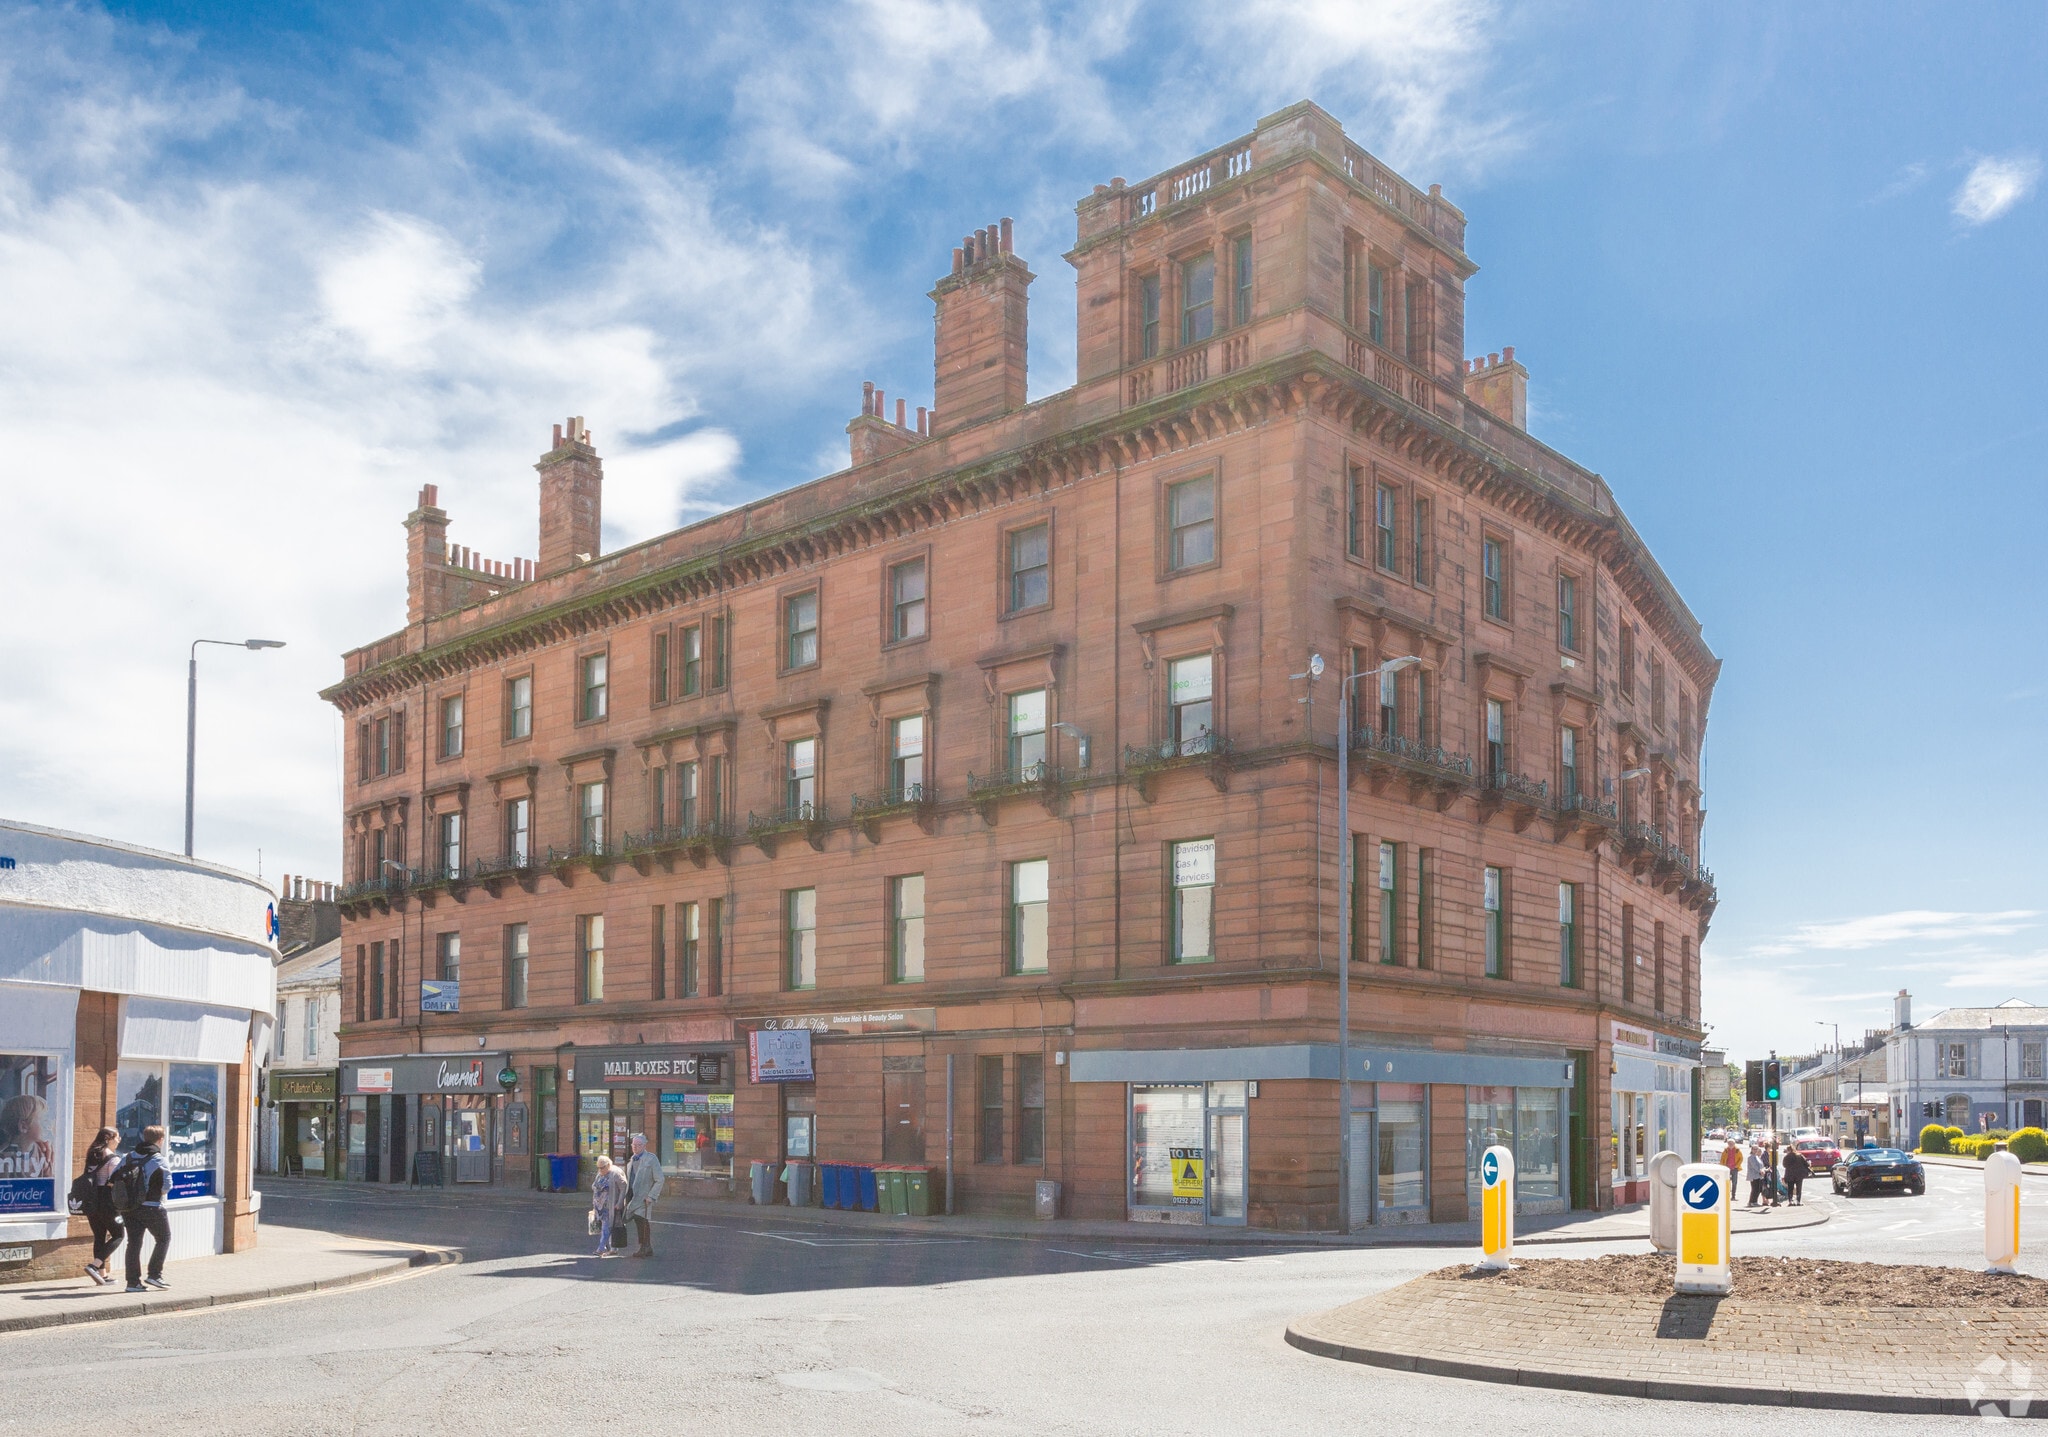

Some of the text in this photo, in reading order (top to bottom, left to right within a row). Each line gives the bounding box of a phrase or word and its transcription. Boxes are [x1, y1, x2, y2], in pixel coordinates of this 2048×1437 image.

[1175, 843, 1215, 854] Davidson
[1175, 860, 1191, 869] Gas
[1175, 871, 1210, 883] Services
[425, 1002, 438, 1010] DM
[851, 1015, 862, 1023] Hair
[868, 1014, 887, 1022] Beauty
[888, 1013, 904, 1021] Salon
[810, 1018, 829, 1034] Vita
[769, 1038, 802, 1050] Future
[437, 1060, 479, 1088] Camerons
[604, 1062, 632, 1075] MAIL
[634, 1061, 670, 1075] BOXES
[290, 1081, 310, 1094] Fullerton
[168, 1150, 213, 1168] Connect
[1170, 1149, 1184, 1158] TO
[0, 1188, 45, 1204] dayrider
